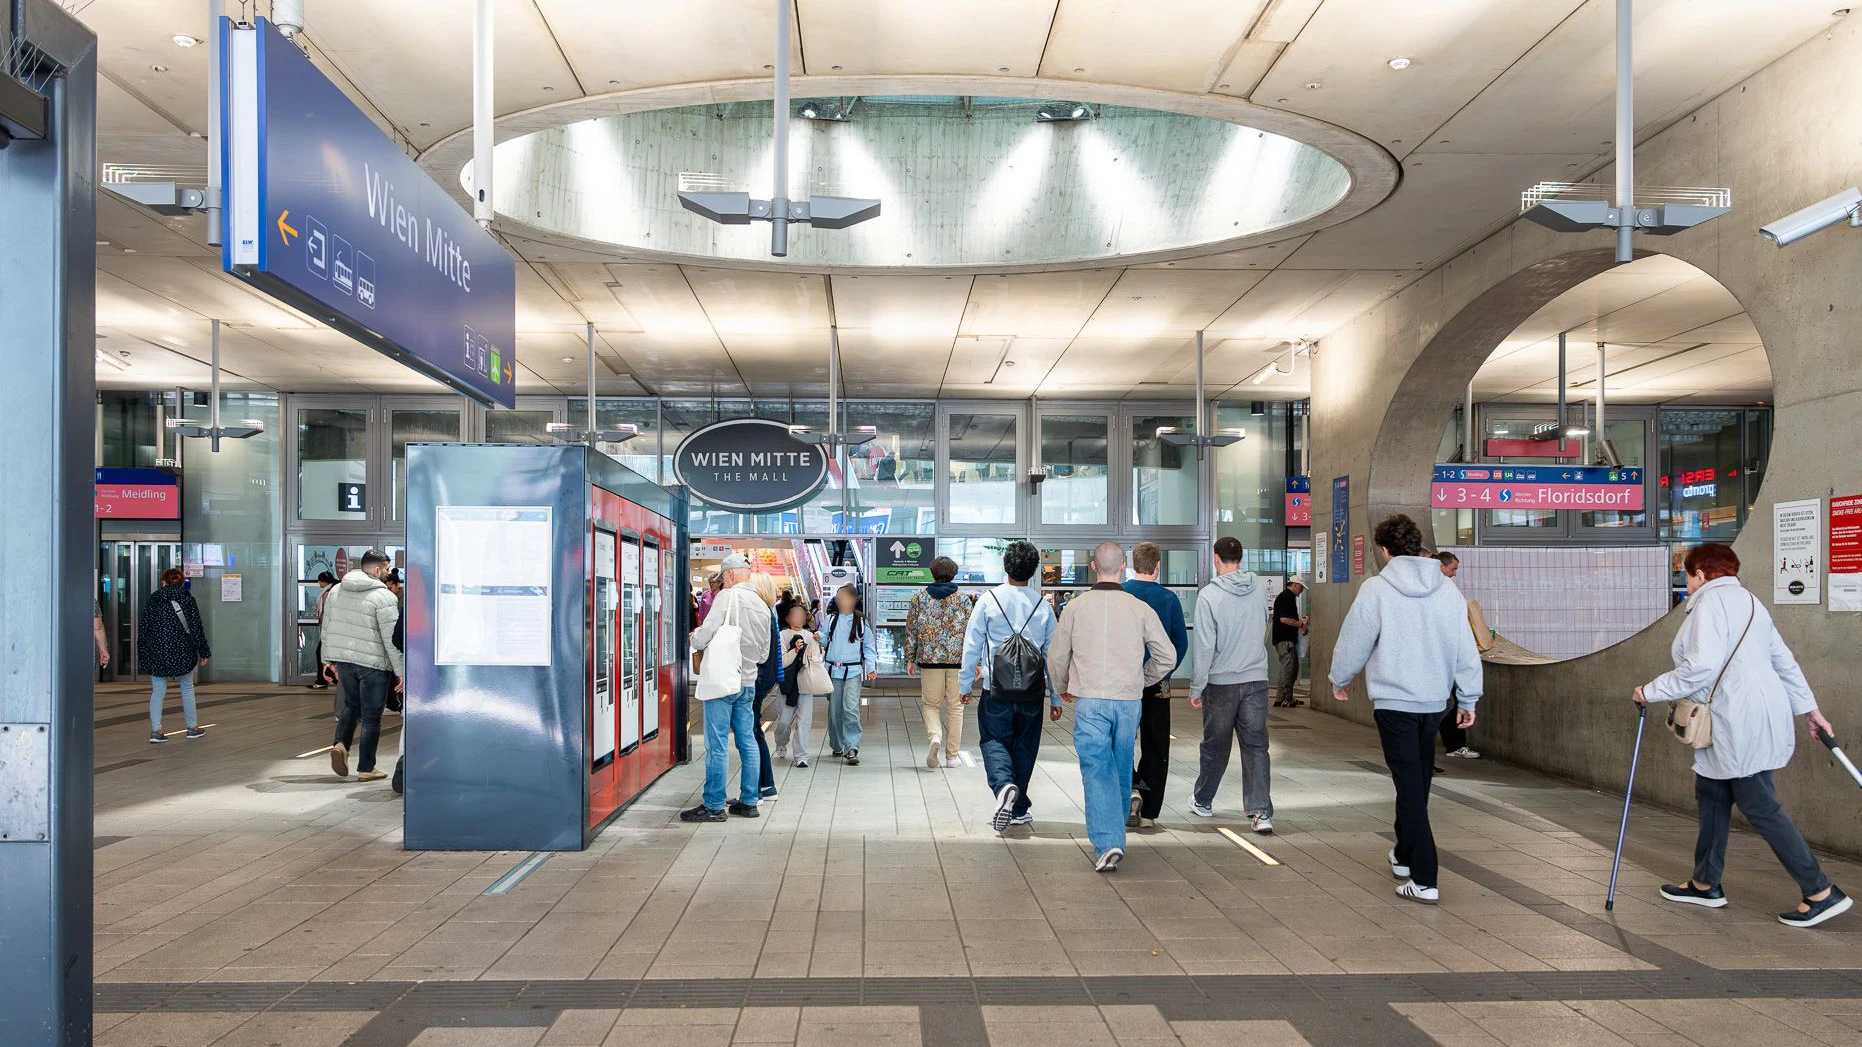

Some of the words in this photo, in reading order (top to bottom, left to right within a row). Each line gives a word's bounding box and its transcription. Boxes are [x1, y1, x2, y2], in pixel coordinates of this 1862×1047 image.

[364, 162, 419, 254] Wien
[426, 217, 471, 293] Mitte
[691, 452, 743, 467] WIEN
[750, 452, 811, 467] MITTE
[714, 472, 742, 482] THE
[749, 472, 788, 482] MALL
[1442, 470, 1455, 479] 1-2
[1621, 472, 1627, 481] 5
[122, 489, 166, 501] Meidling
[1538, 488, 1631, 504] Floridsdorf
